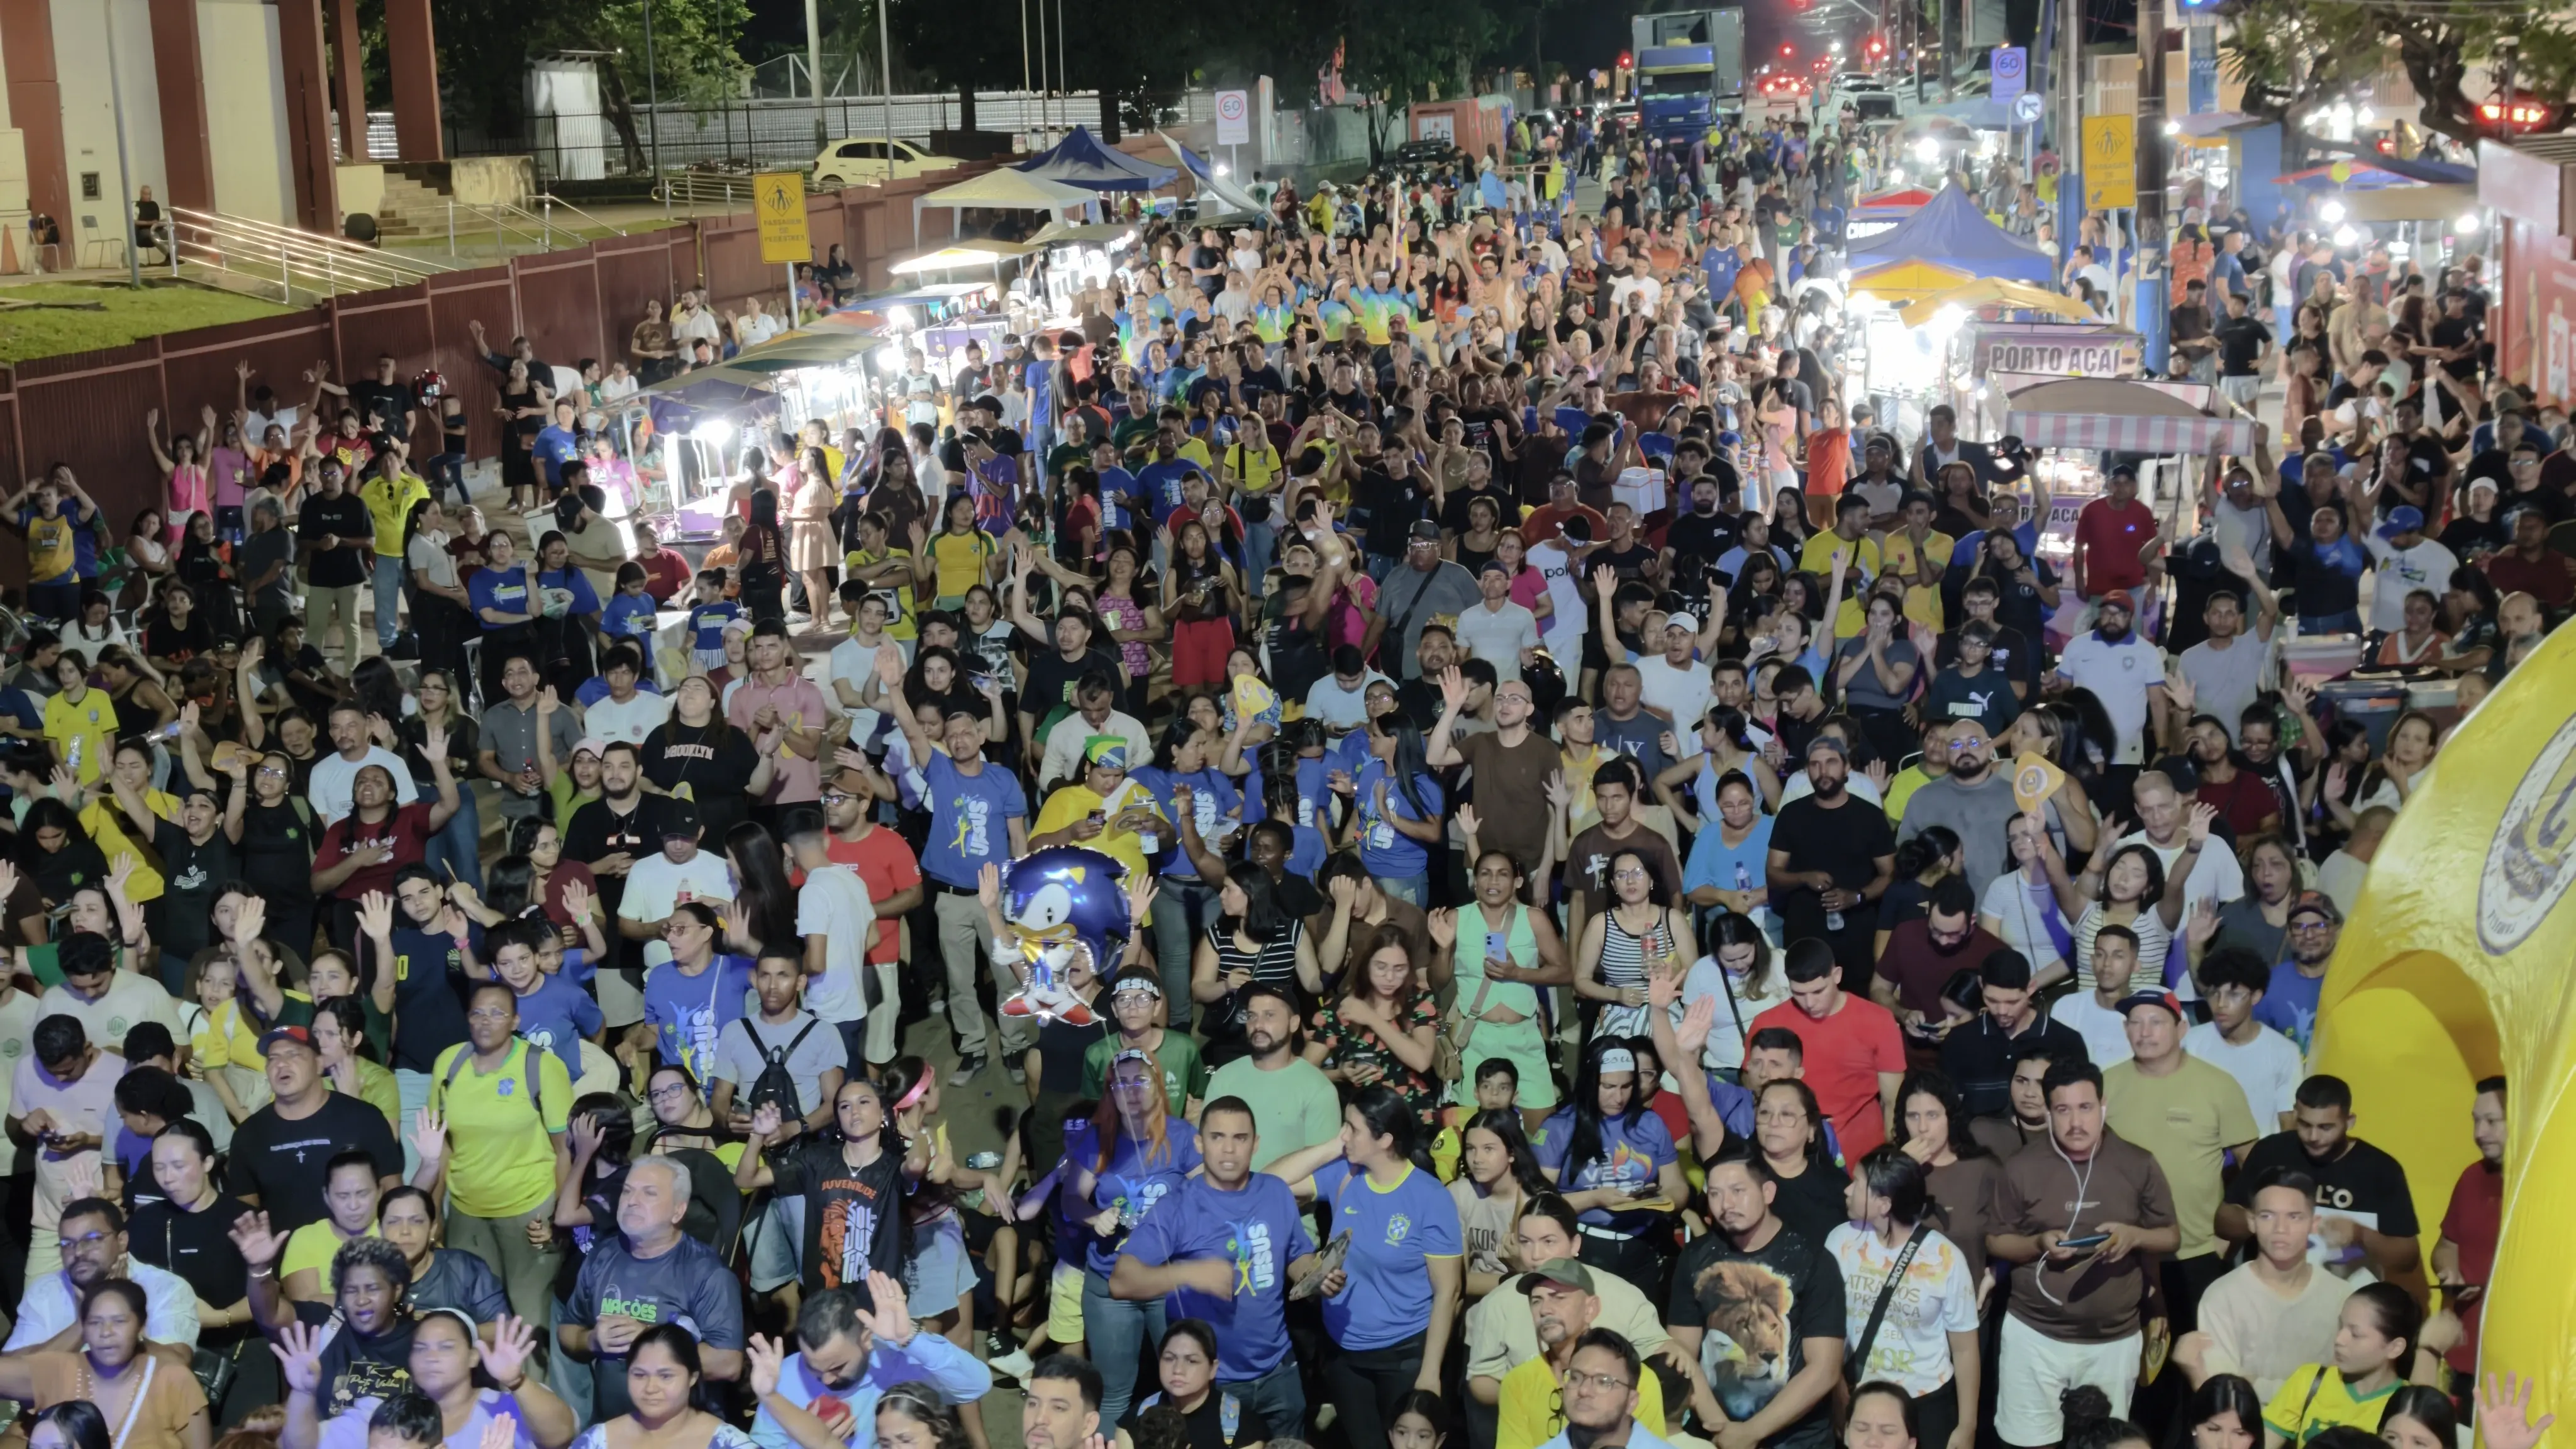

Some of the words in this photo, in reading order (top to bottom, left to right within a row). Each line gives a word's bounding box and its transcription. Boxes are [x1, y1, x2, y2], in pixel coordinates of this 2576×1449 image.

[2000, 57, 2018, 69] 60
[1223, 100, 1241, 112] 60
[1991, 346, 2063, 372] PORTO
[664, 744, 714, 761] BROOKLYN
[1194, 792, 1217, 838] ESUS
[971, 801, 990, 856] JESUS
[820, 1179, 876, 1200] JUVENTUDE
[1247, 1223, 1274, 1290] JESUS
